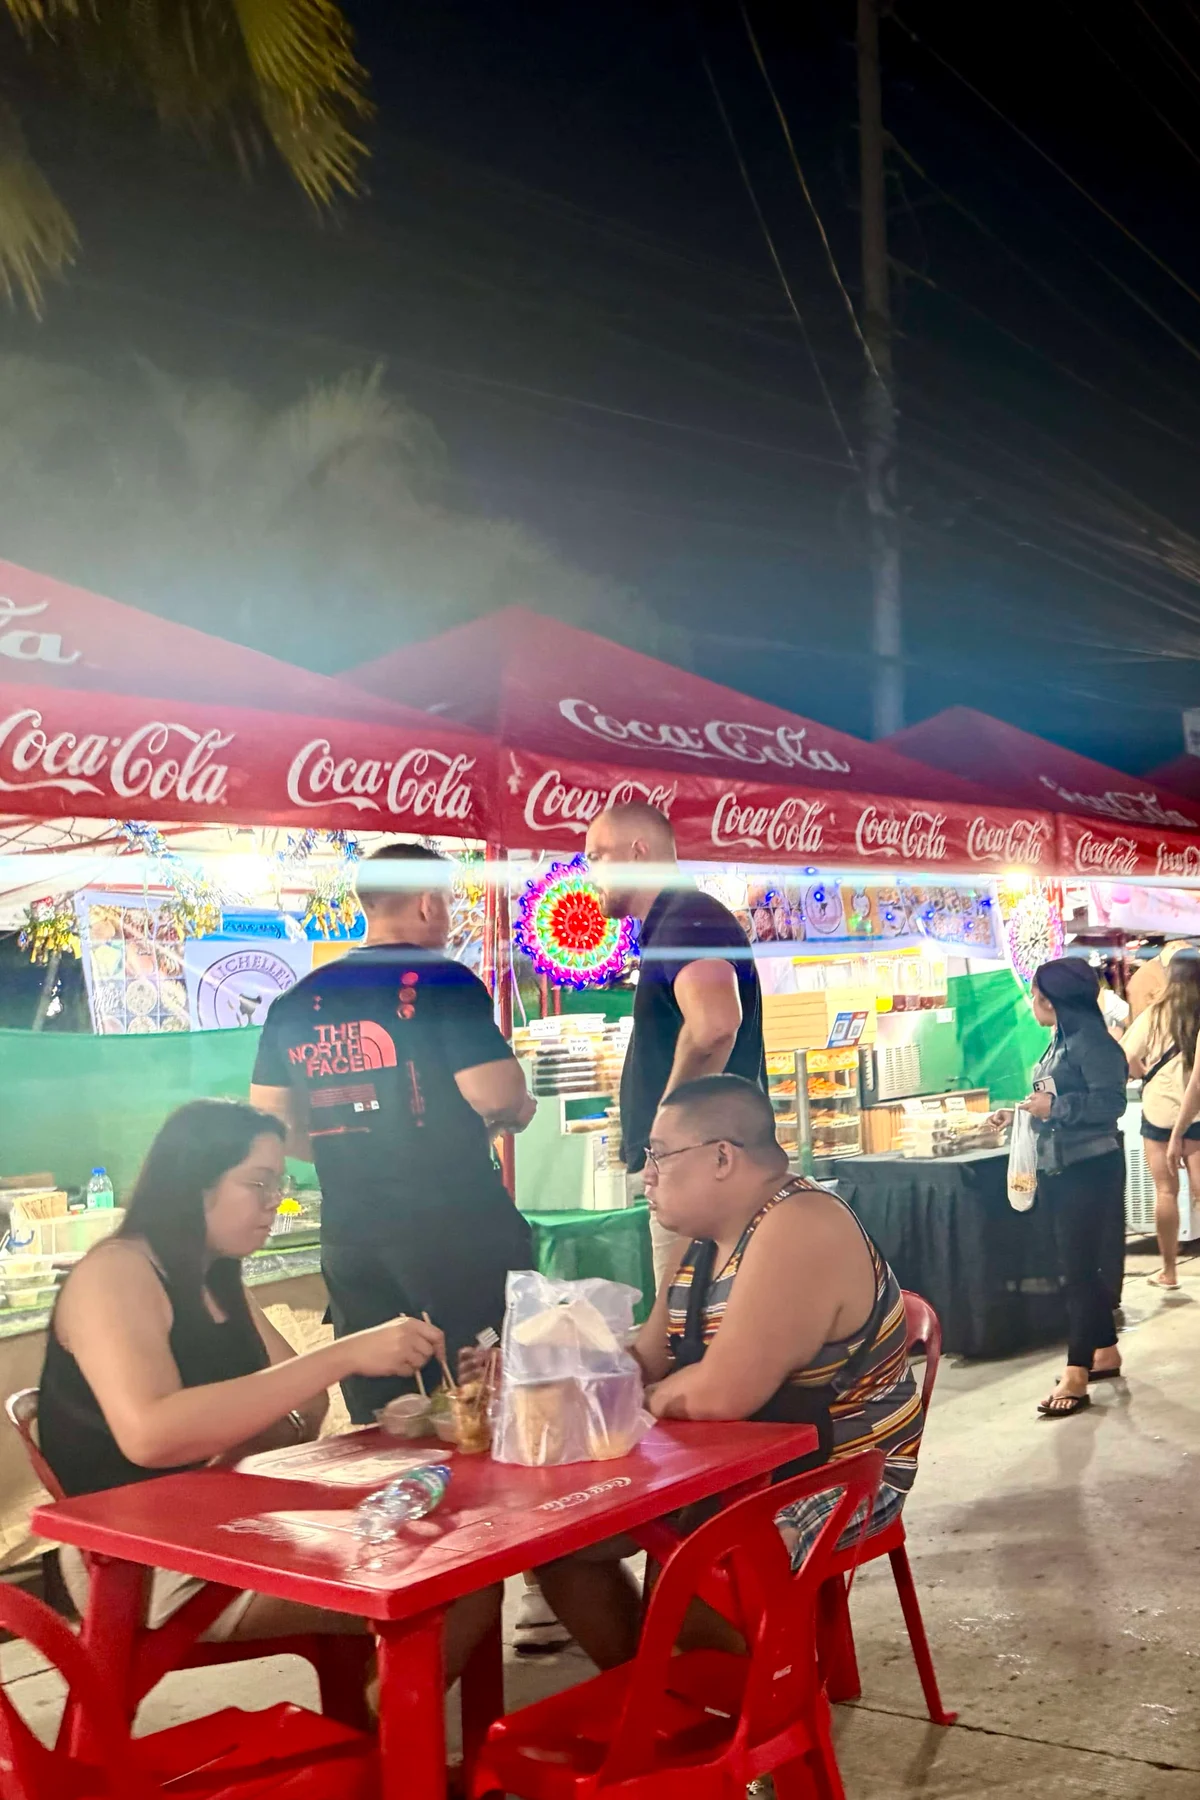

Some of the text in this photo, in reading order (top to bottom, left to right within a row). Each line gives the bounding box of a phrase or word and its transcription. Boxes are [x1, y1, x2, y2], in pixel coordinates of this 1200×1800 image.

[0, 708, 237, 805] Coca-Cola
[558, 698, 850, 773] Coca-Cola
[287, 738, 477, 820] Coca-Cola
[711, 792, 826, 852] Coca-Cola
[855, 805, 947, 860] Coca-Cola
[967, 816, 1043, 864] Coca-Cola
[1074, 831, 1139, 876] Coca-Cola
[288, 1038, 362, 1065] NORTH
[313, 1021, 359, 1043] THE
[306, 1055, 365, 1078] FACE
